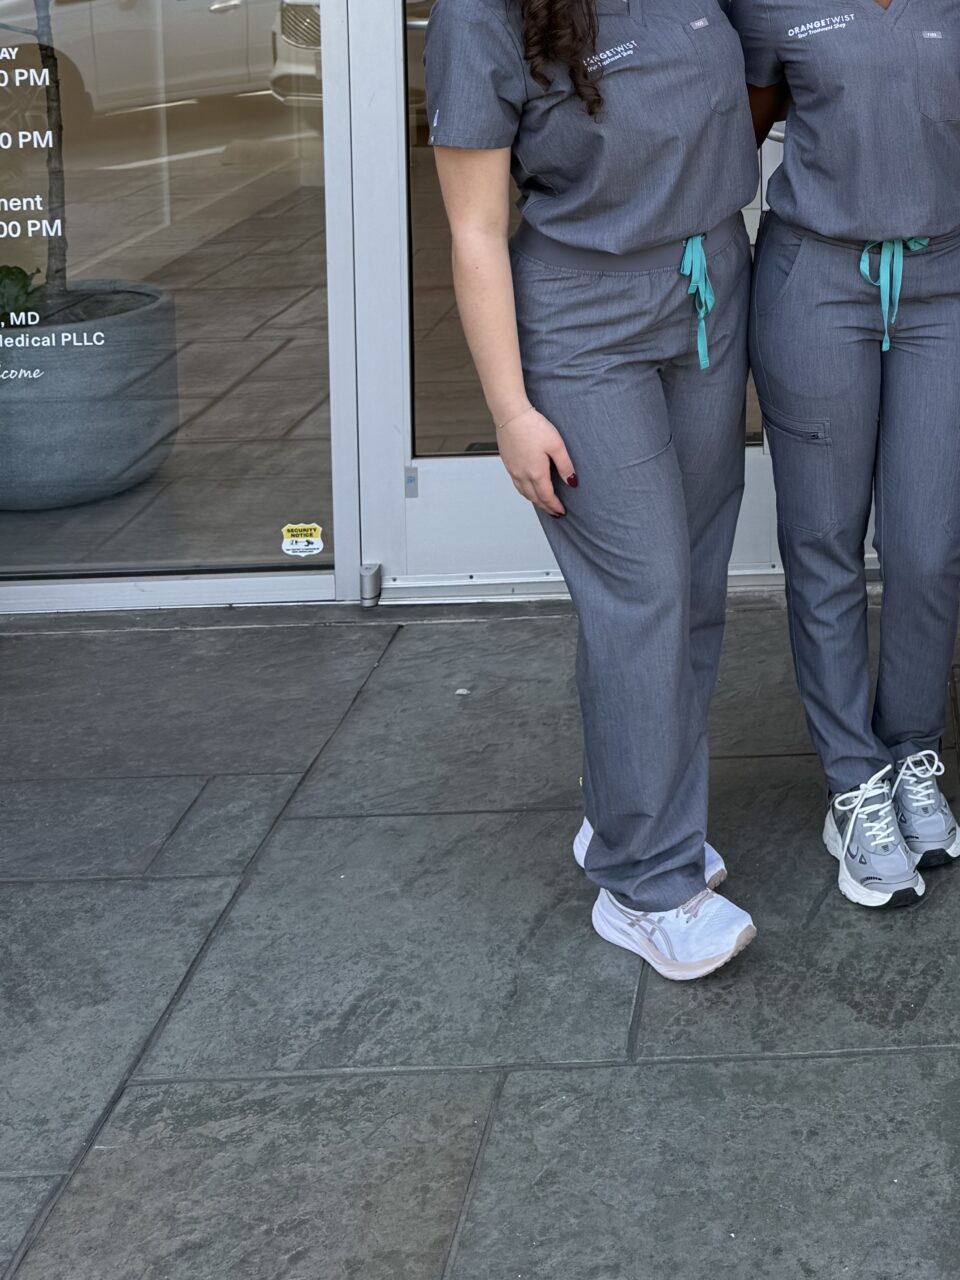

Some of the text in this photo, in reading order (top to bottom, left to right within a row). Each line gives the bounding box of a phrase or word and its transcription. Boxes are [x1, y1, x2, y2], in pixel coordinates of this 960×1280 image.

[788, 14, 855, 37] ORANGETWIST
[14, 68, 50, 86] PM
[18, 130, 53, 148] PM
[28, 219, 62, 237] PM
[10, 312, 40, 326] MD
[0, 332, 104, 348] edical PLLC
[0, 367, 44, 380] come
